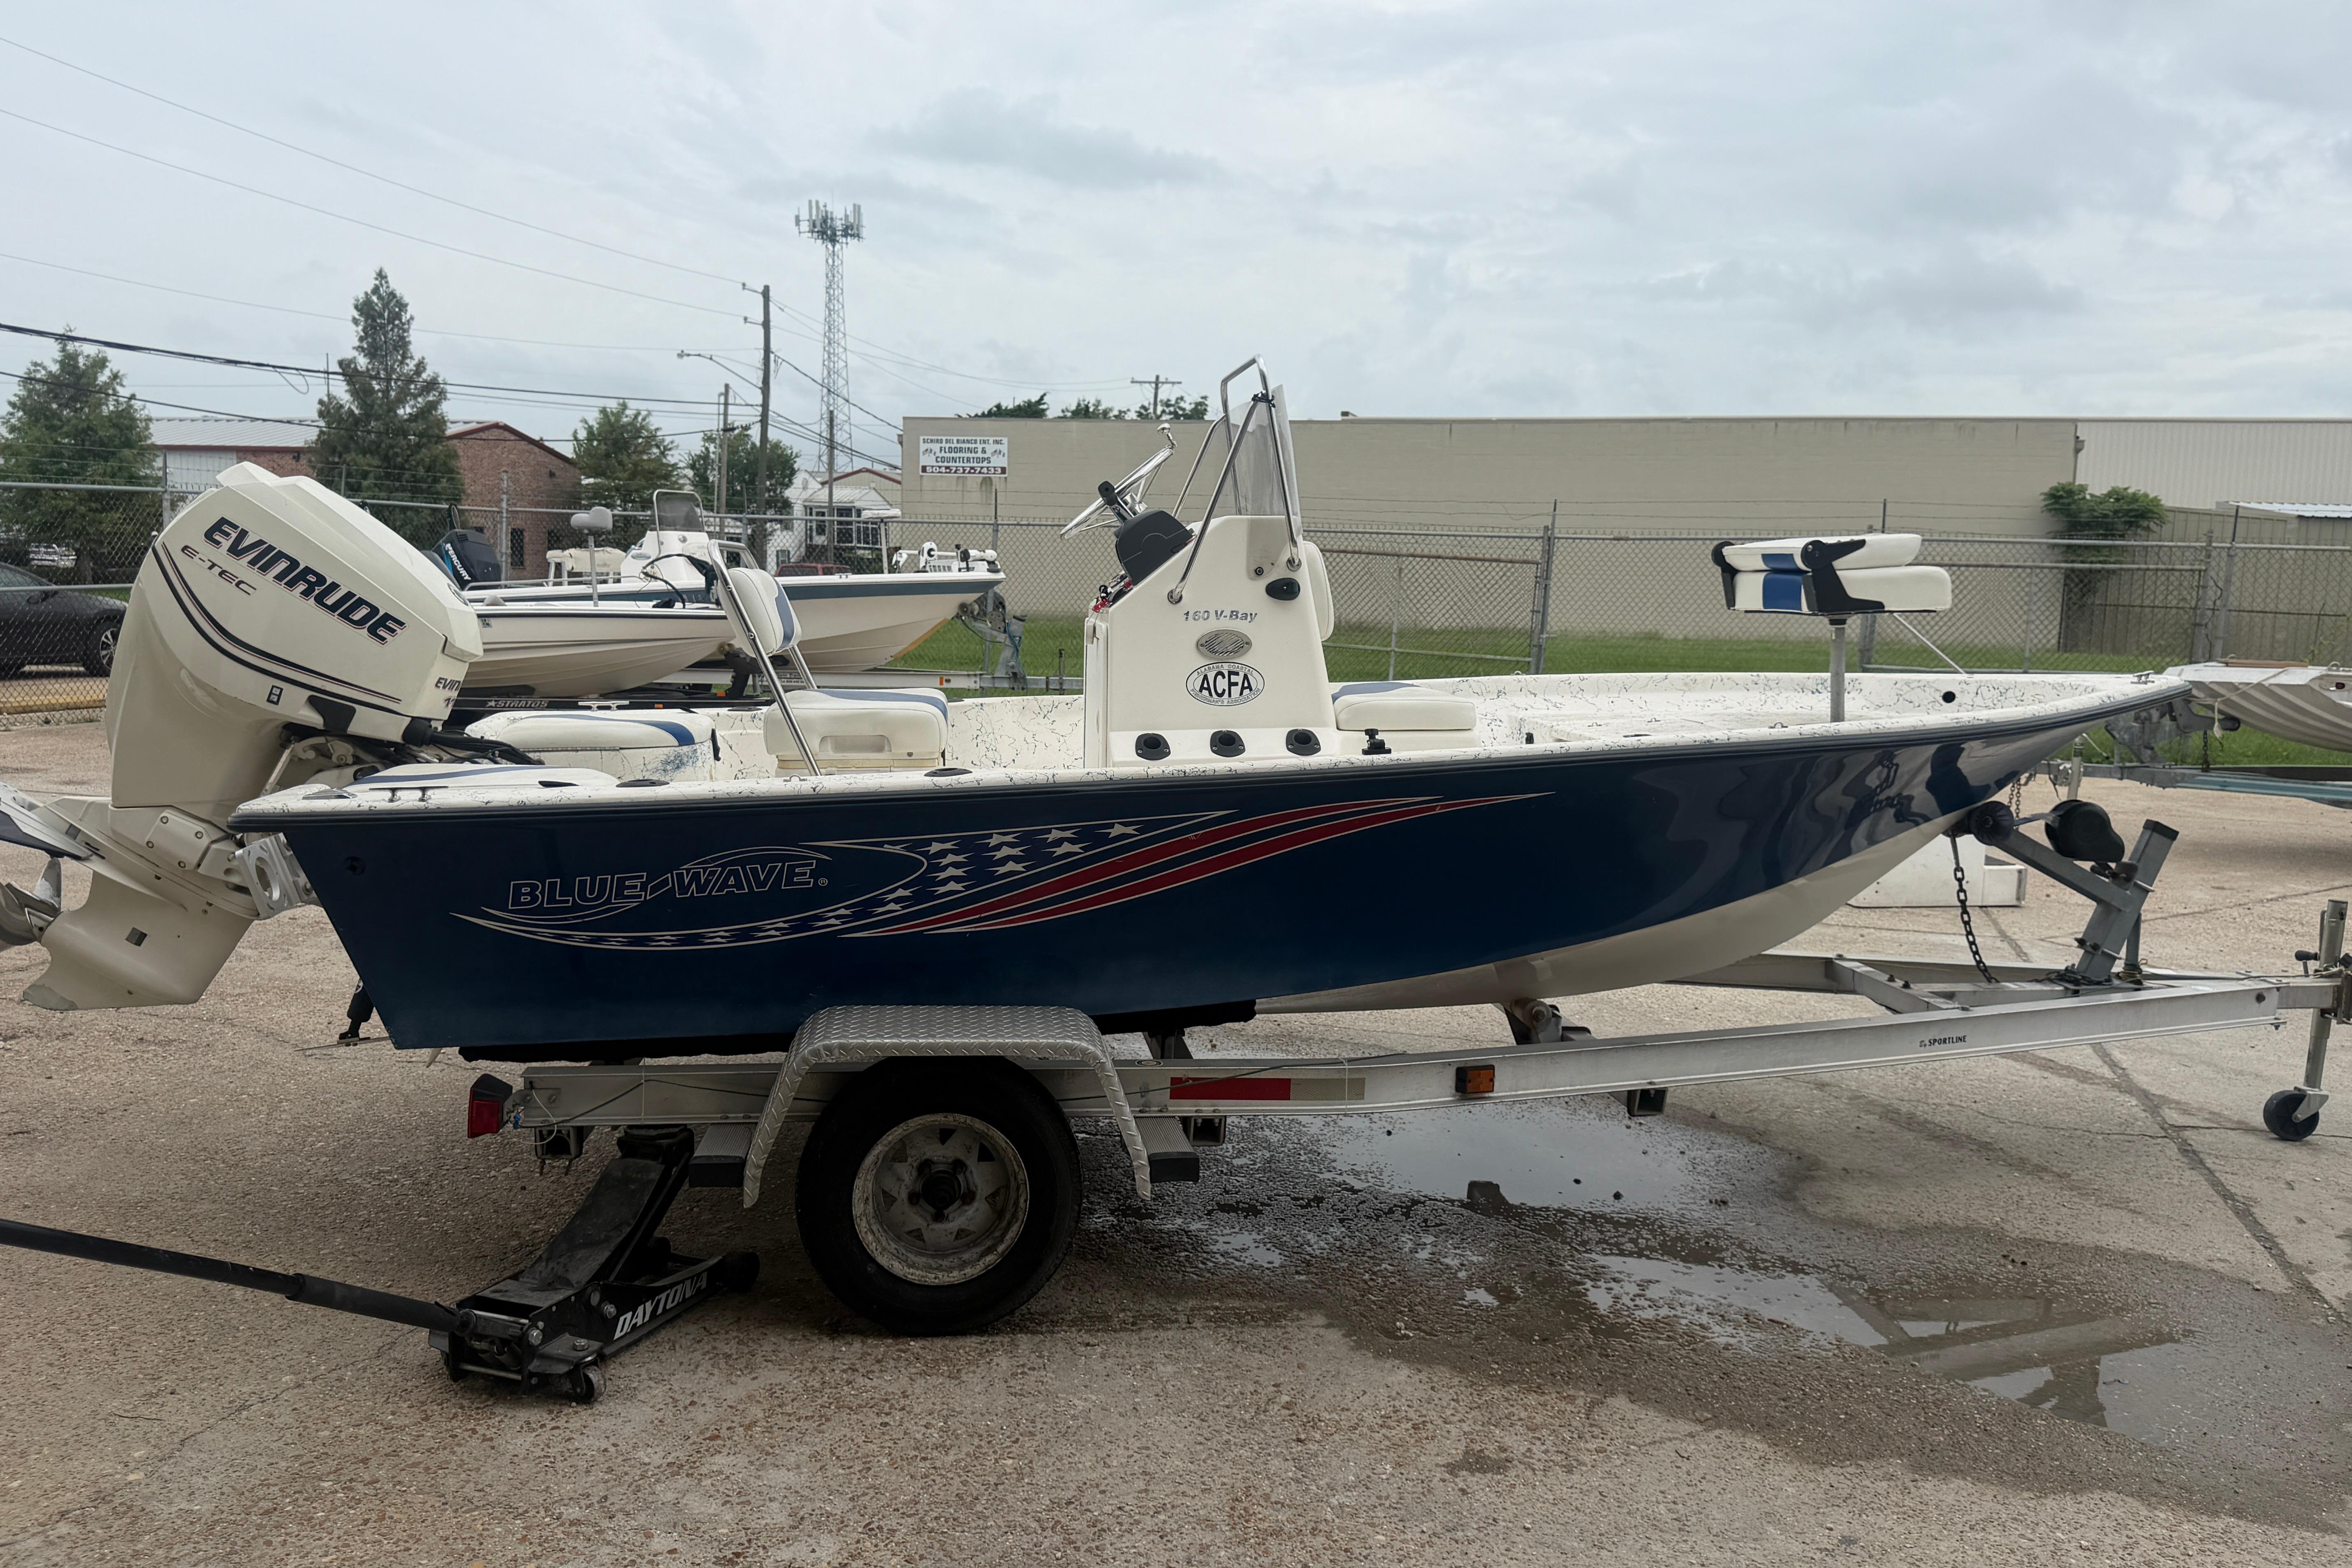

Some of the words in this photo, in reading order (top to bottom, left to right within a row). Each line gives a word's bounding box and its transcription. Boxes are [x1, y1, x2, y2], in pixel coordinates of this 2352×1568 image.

[181, 545, 257, 596] E-TEC
[443, 543, 471, 580] MERCURY
[203, 516, 408, 645] EVINRUDE
[1184, 610, 1210, 621] 160
[1215, 610, 1258, 623] V-Bay
[1199, 670, 1253, 698] ACFA
[1228, 664, 1254, 675] COASTAL
[509, 872, 647, 909] BLUE
[1928, 1035, 1967, 1046] SPORTLINE
[613, 1271, 707, 1341] DAYTONA
